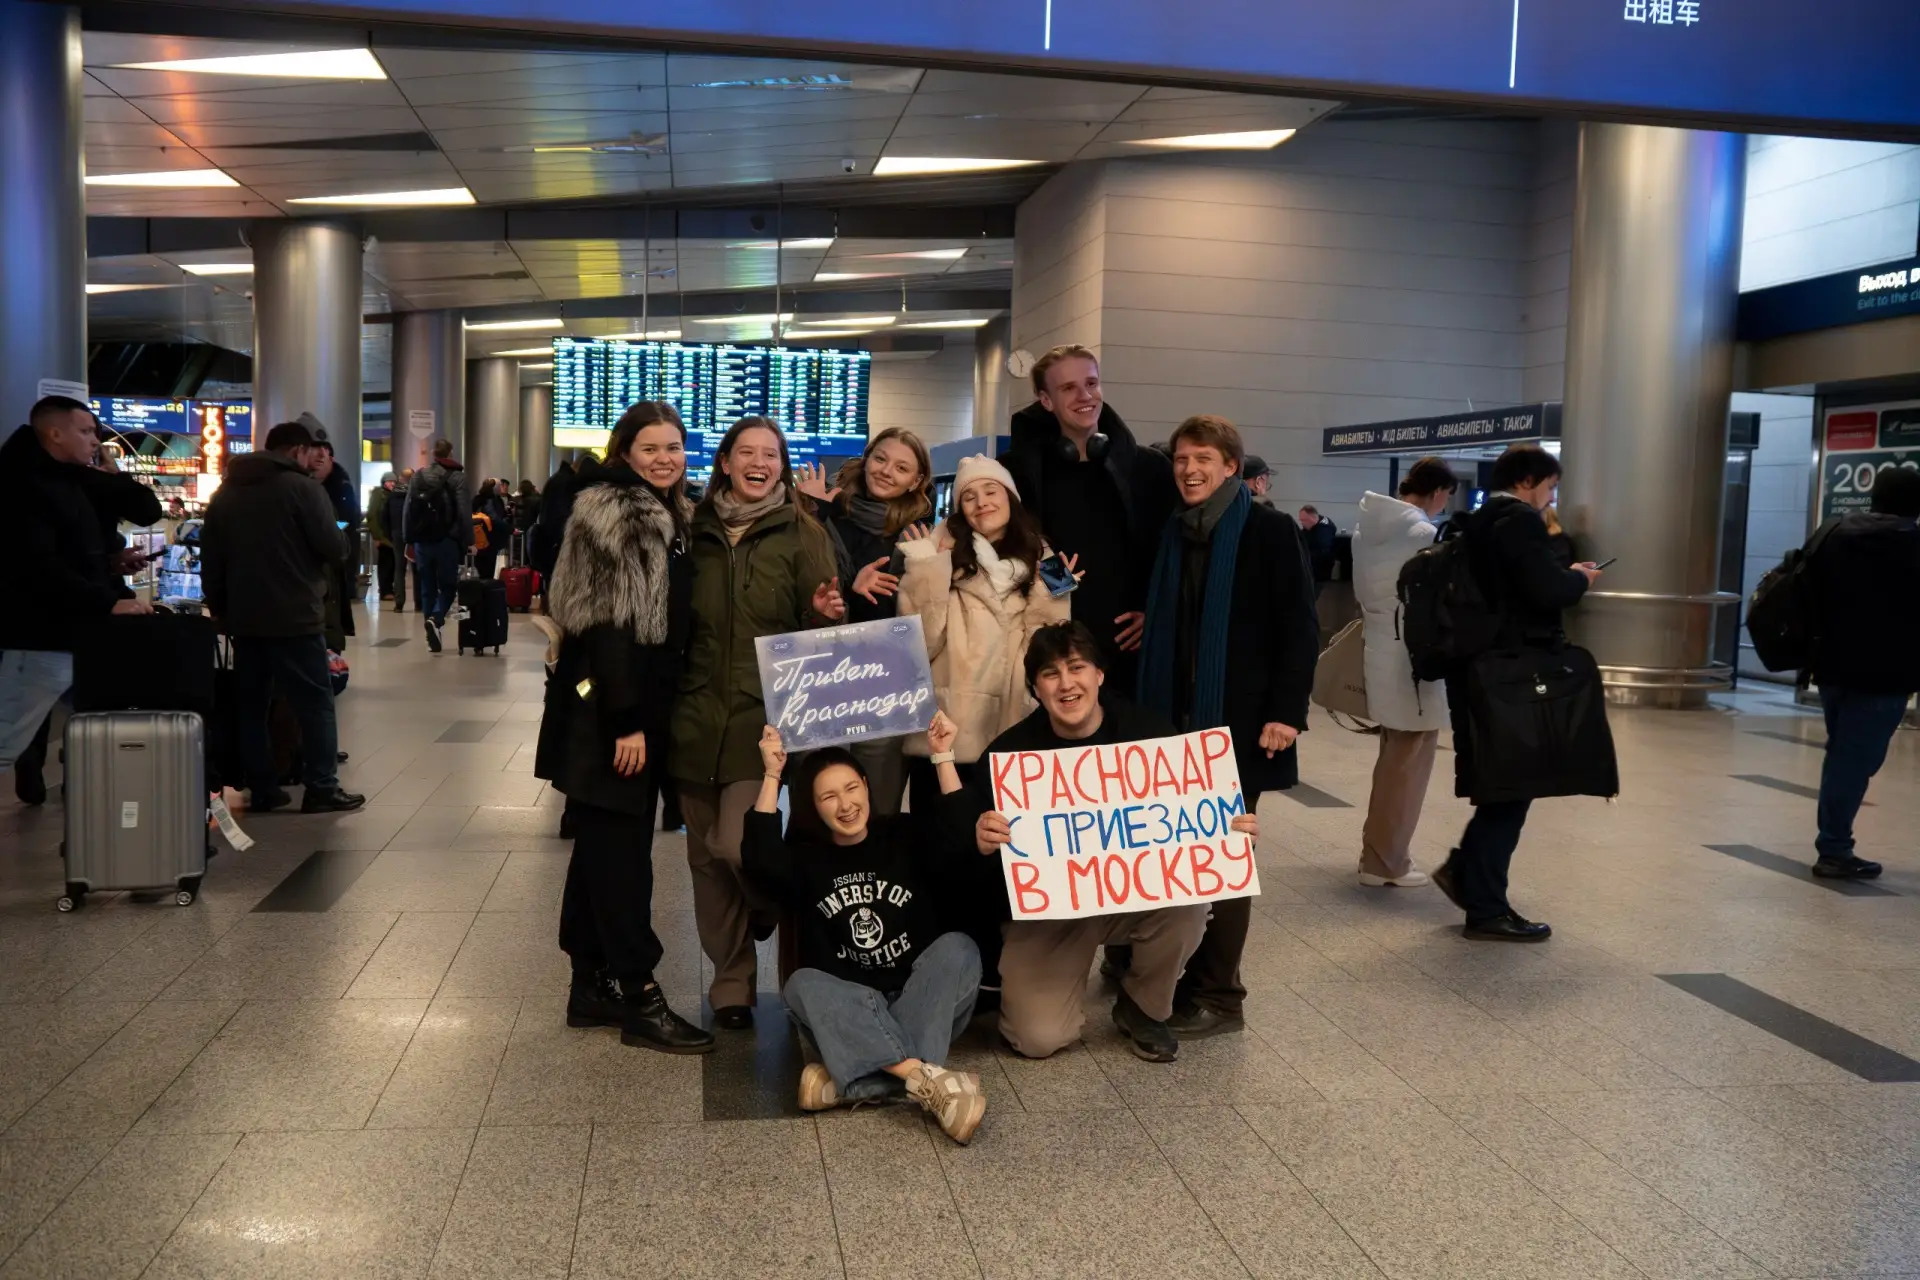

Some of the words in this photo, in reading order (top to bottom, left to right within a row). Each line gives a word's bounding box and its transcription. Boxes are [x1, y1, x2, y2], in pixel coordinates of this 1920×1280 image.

[1624, 0, 1700, 27] 出租车
[1331, 430, 1375, 446] АВИАБИЛЕТЫ
[1396, 426, 1428, 441] БИЛЕТЫ
[1437, 419, 1495, 438] АВИАБИЛЕТЫ
[1503, 414, 1534, 431] ТАКСИ
[1833, 461, 1919, 493] 20
[776, 687, 929, 736] Краснодар
[1008, 815, 1029, 858] С
[1043, 792, 1247, 857] ПРИЕЗДОМ
[1011, 862, 1050, 914] В
[1067, 837, 1254, 911] МОСКВУ
[888, 884, 913, 908] OF
[837, 932, 911, 966] JUSTICE
